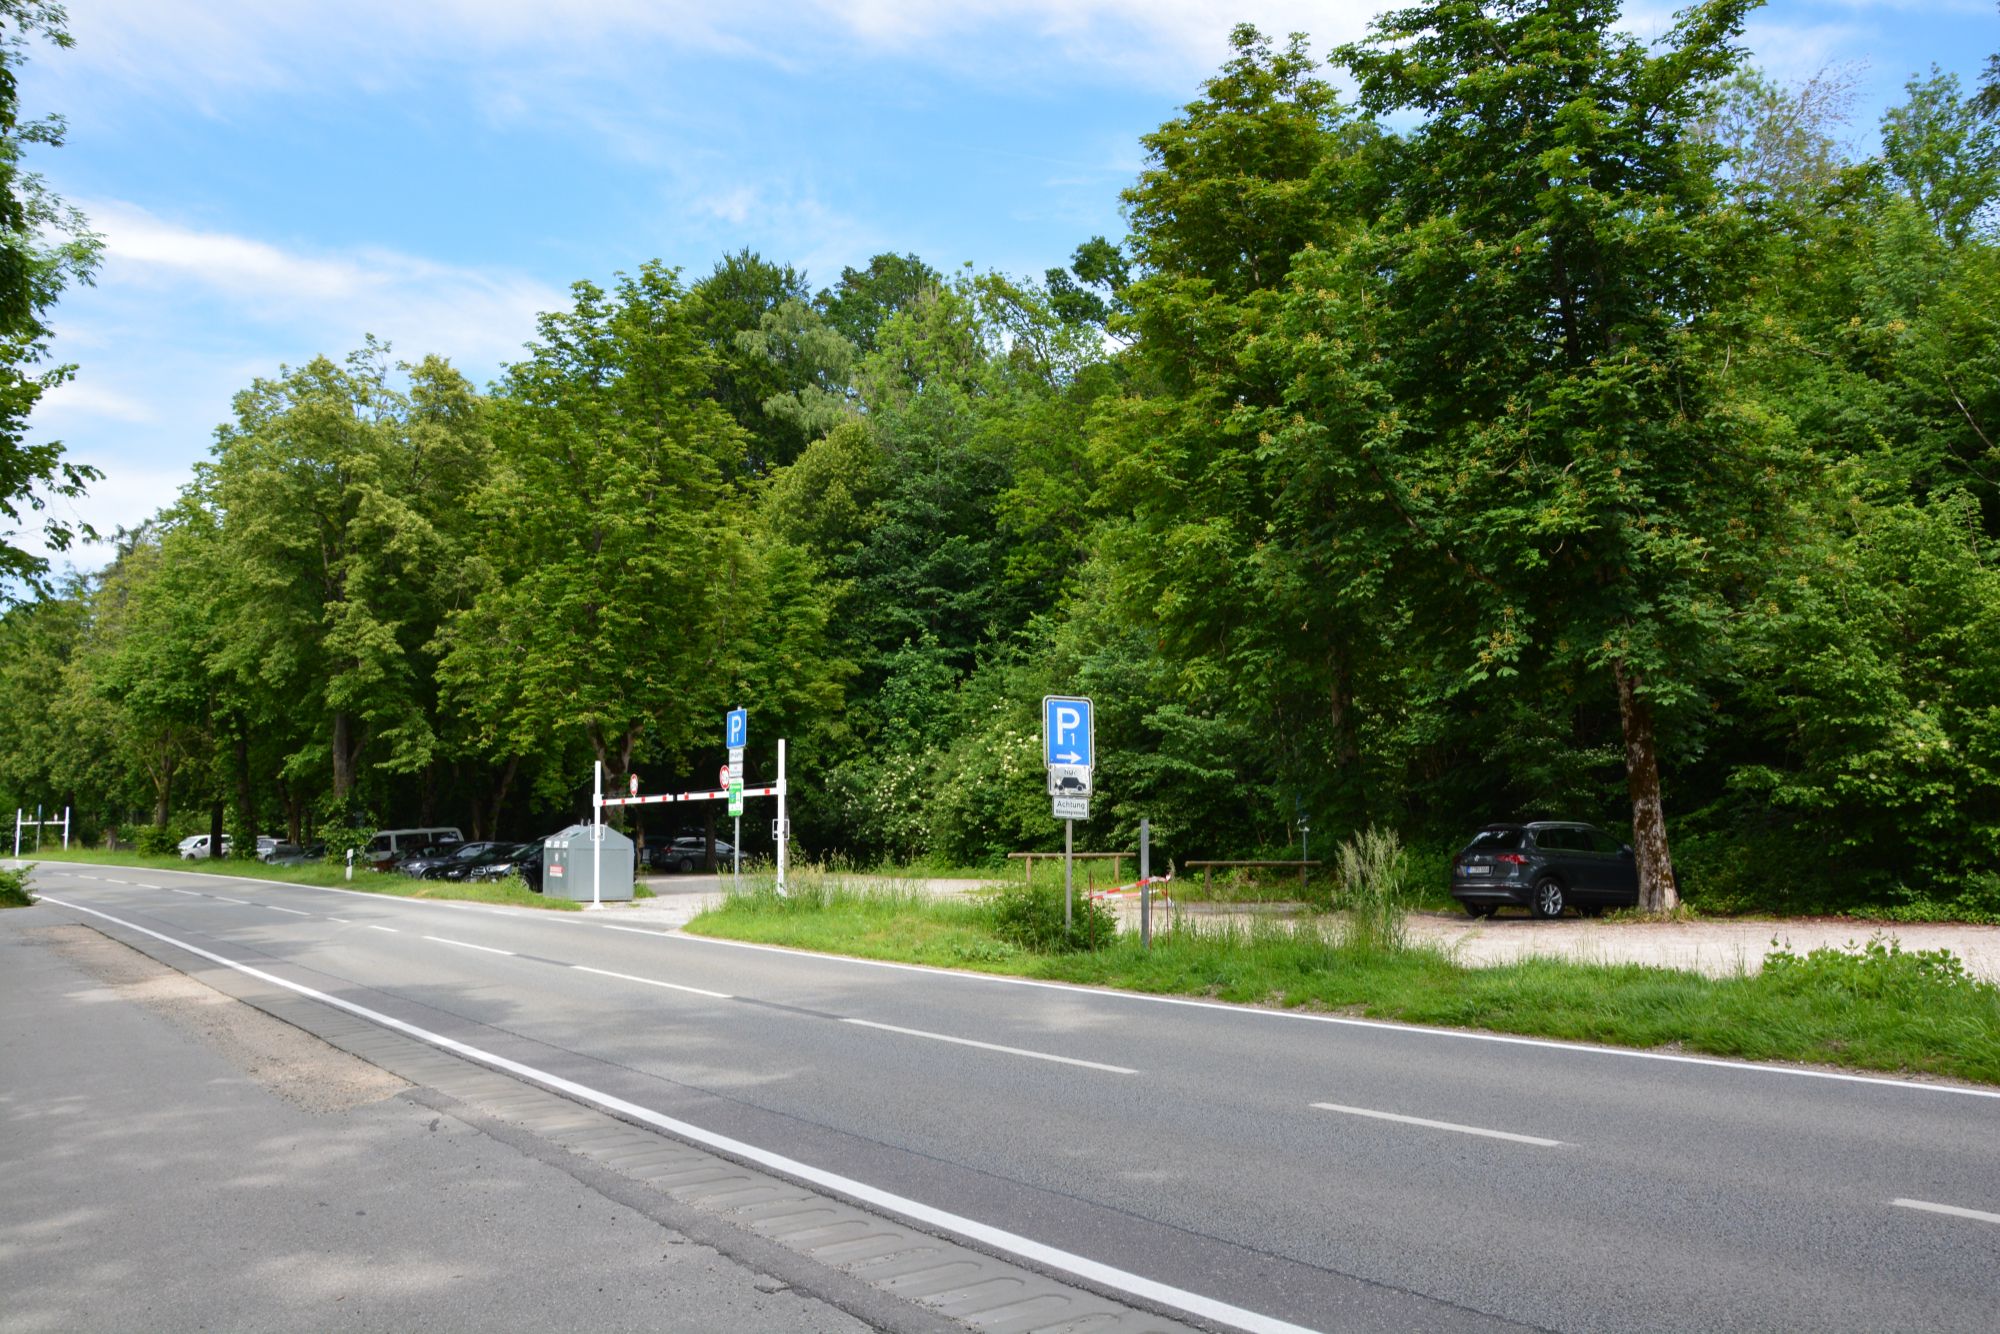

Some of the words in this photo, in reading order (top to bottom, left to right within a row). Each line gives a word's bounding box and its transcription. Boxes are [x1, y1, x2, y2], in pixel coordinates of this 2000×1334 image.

[731, 715, 742, 744] P
[1057, 707, 1080, 746] P
[1057, 800, 1086, 810] Achtung
